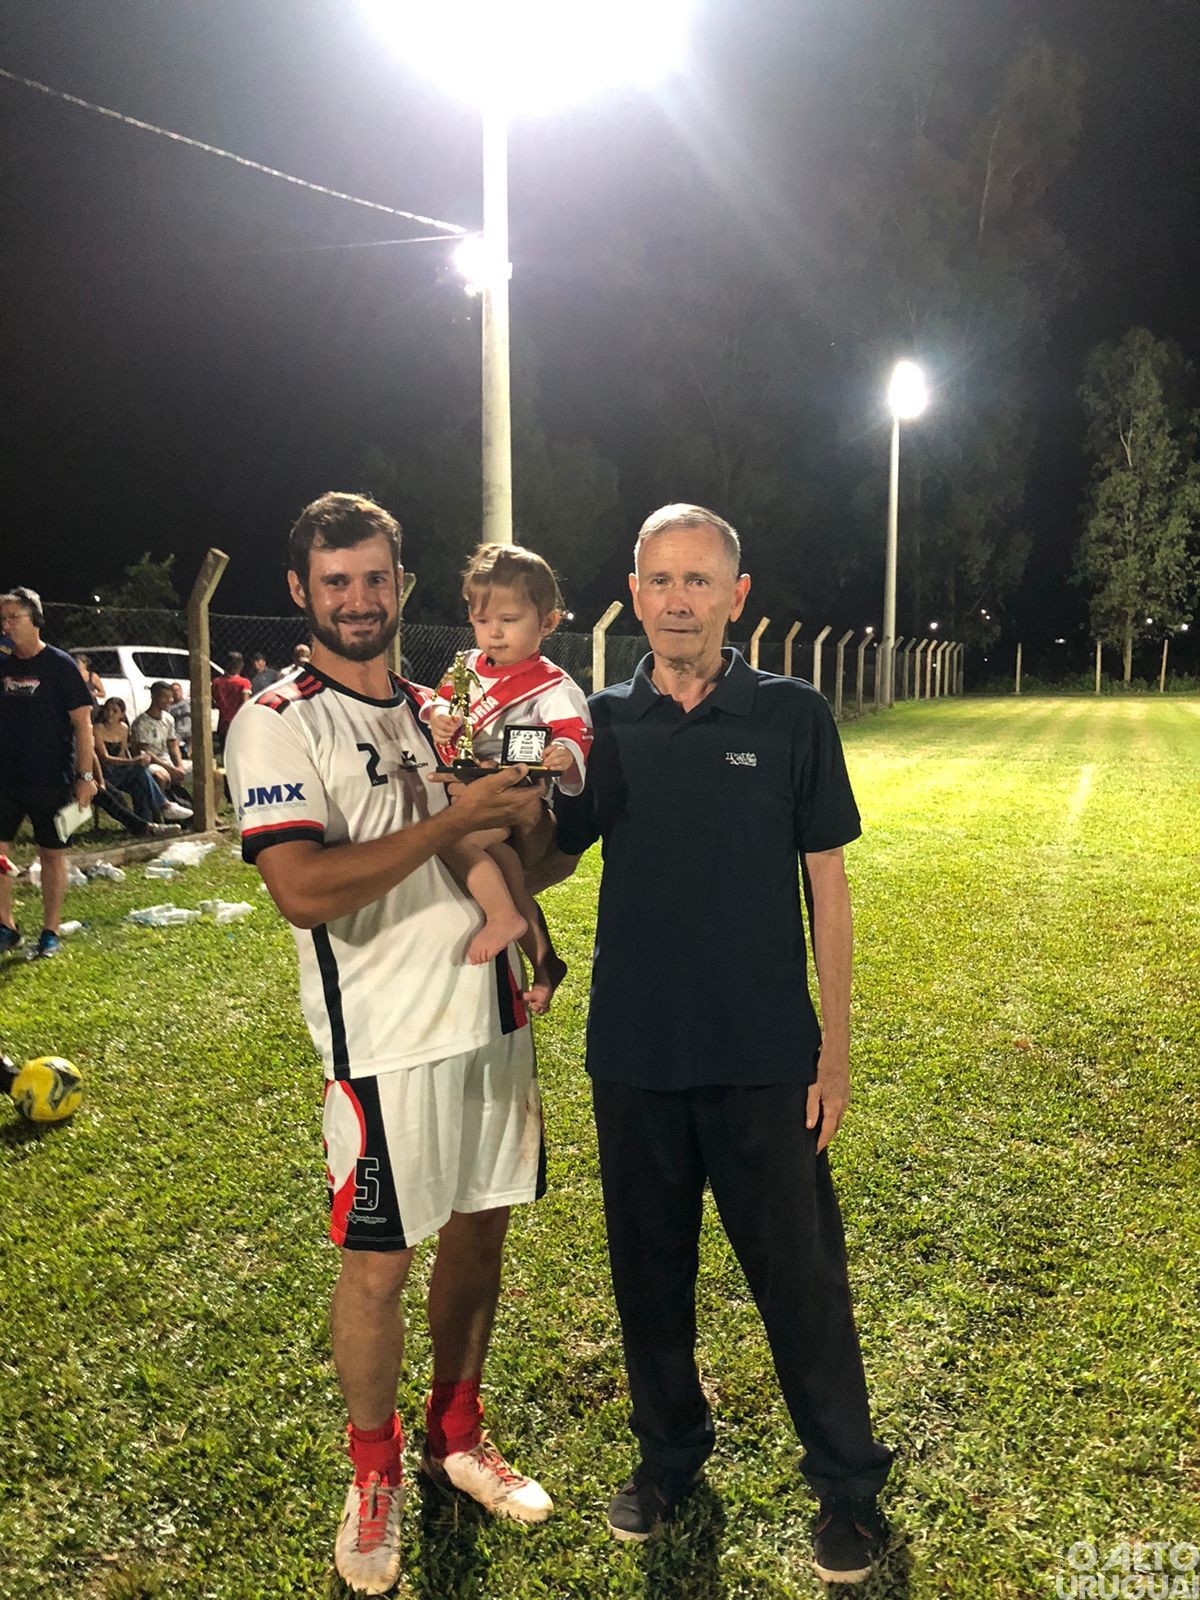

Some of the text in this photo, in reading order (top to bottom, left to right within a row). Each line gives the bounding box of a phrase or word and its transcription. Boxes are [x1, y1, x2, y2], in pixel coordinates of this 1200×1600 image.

[356, 743, 388, 787] 2
[244, 783, 307, 807] JMX
[353, 1156, 380, 1211] 5
